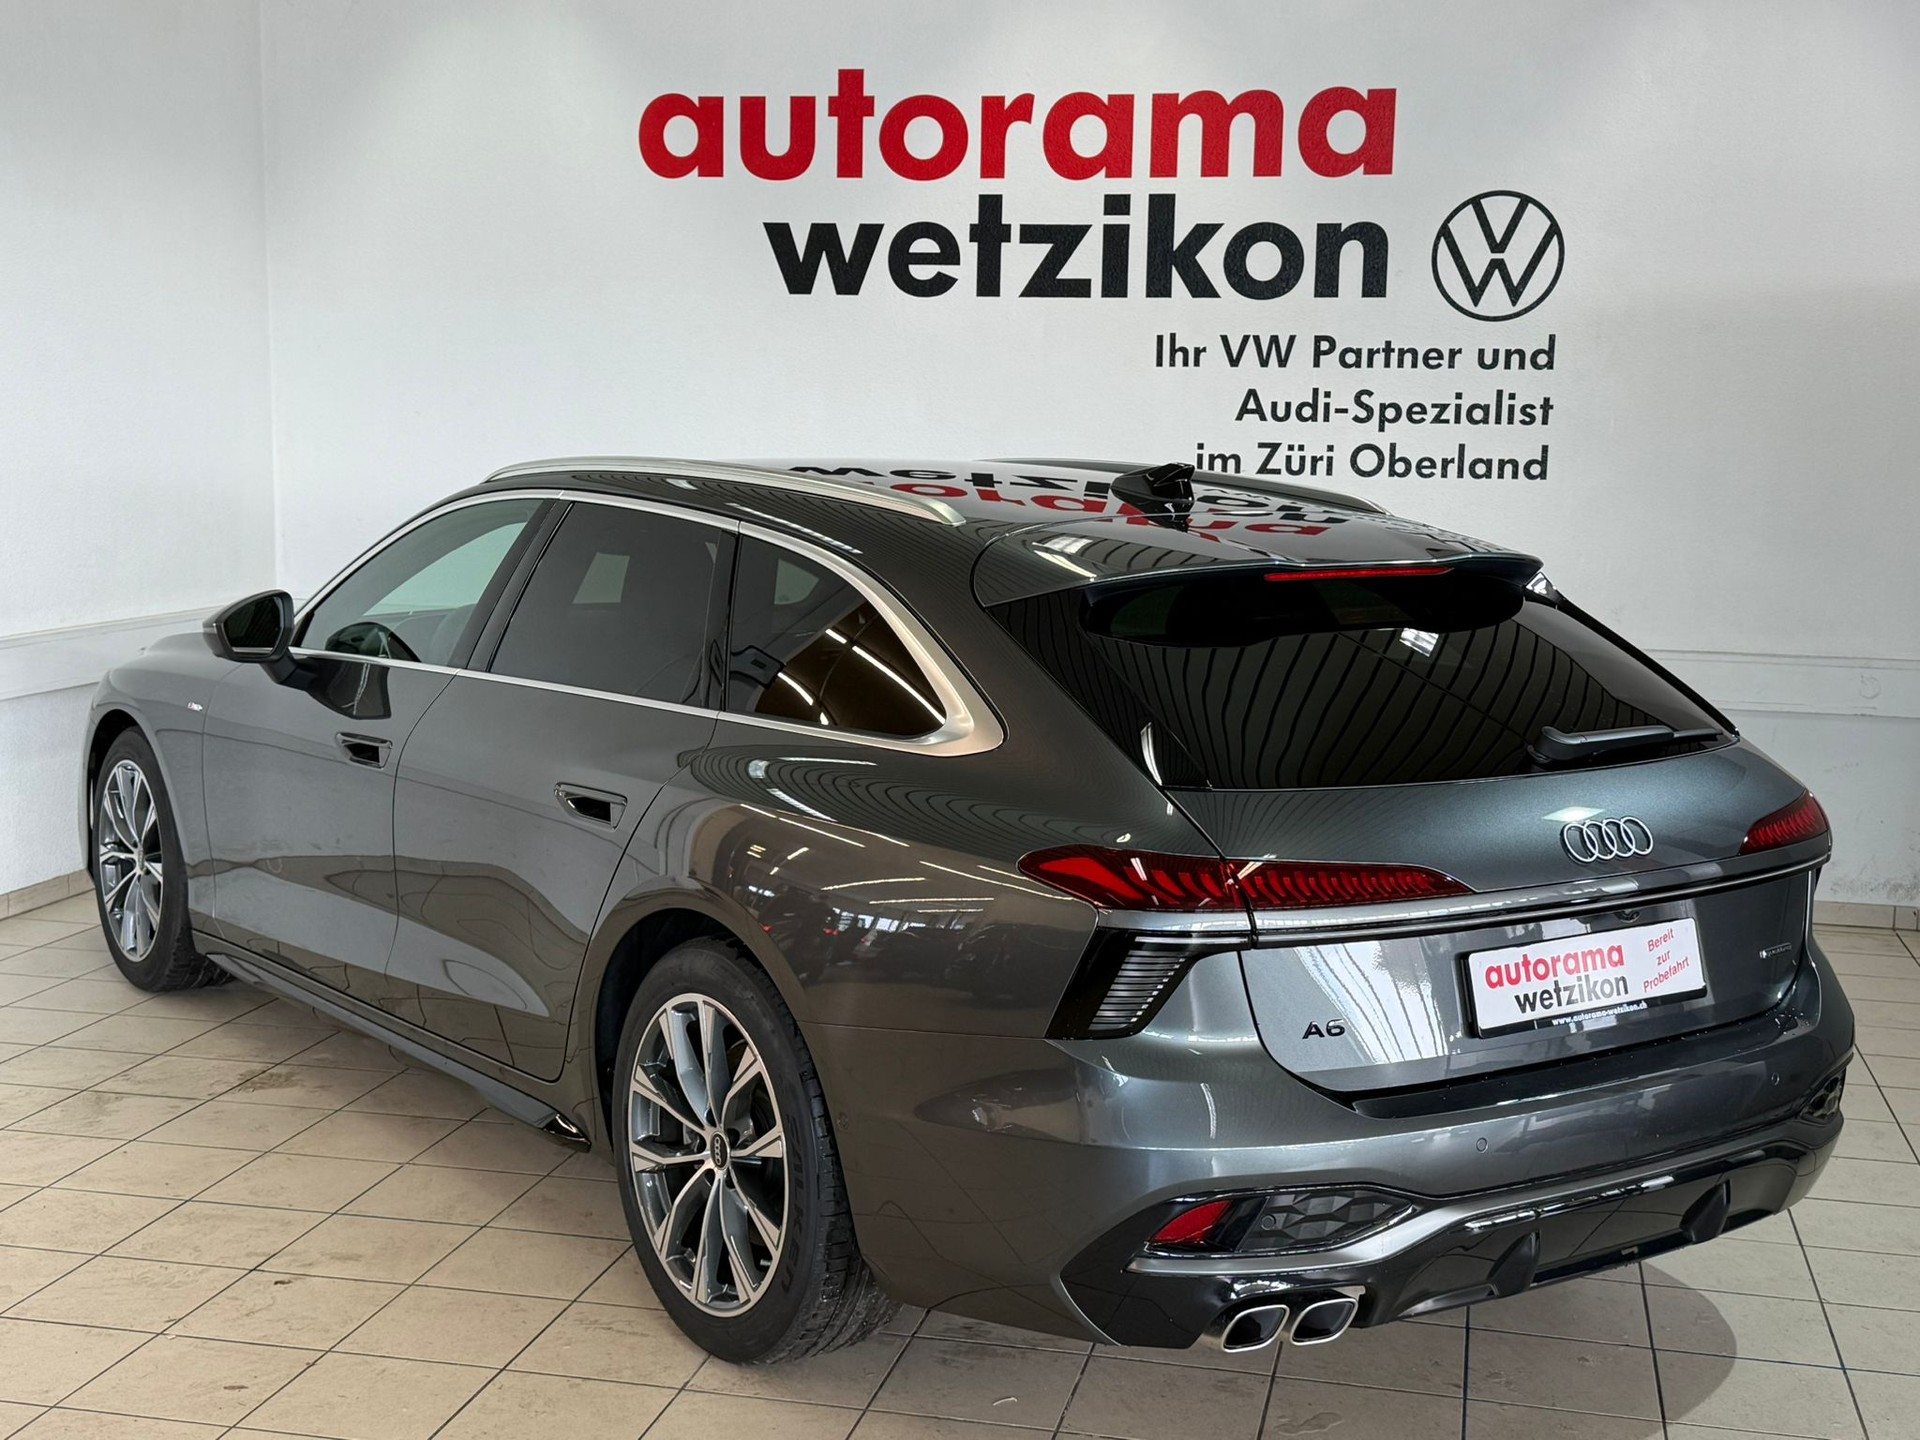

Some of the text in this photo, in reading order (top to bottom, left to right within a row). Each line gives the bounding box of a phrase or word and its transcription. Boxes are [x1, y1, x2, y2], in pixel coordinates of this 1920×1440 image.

[638, 69, 1397, 181] autorama
[763, 194, 1388, 300] wetzikon
[1155, 333, 1556, 371] Ihr VW Partner und
[1235, 388, 1554, 432] Audi-Spezialist
[1196, 442, 1549, 481] im Züri Oberland
[1647, 928, 1675, 952] Bereit
[1656, 951, 1671, 966] zur
[1485, 945, 1624, 989] autorama
[1643, 956, 1689, 993] Probefahrt
[1514, 975, 1629, 1014] wetzikon
[1302, 1019, 1346, 1039] A6
